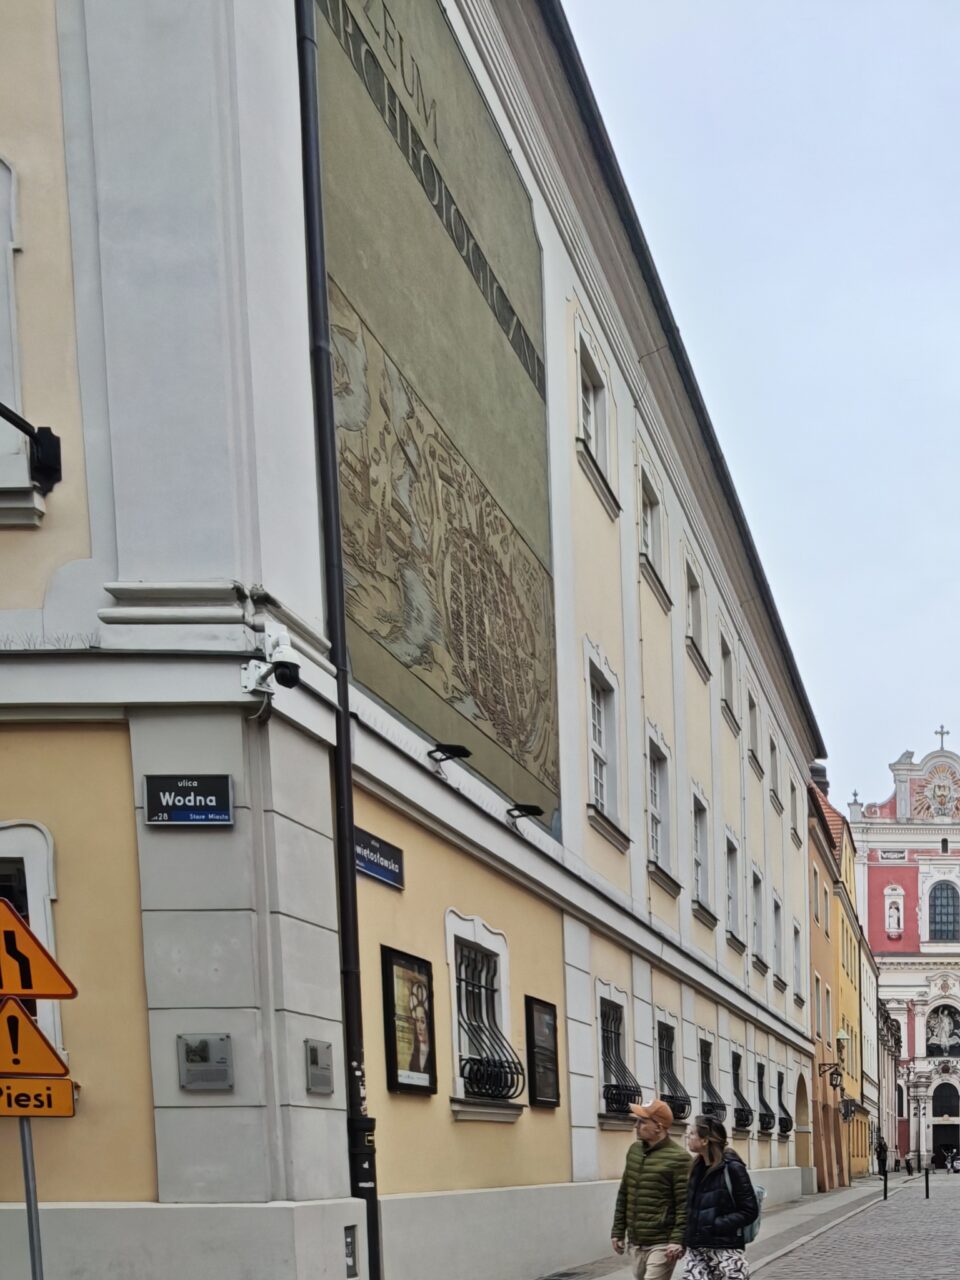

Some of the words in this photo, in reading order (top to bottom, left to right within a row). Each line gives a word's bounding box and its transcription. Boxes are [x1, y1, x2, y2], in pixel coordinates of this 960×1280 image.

[177, 779, 198, 787] ulica
[159, 791, 217, 807] Wodna
[355, 843, 399, 873] więtosławska
[0, 1086, 53, 1109] iesi
